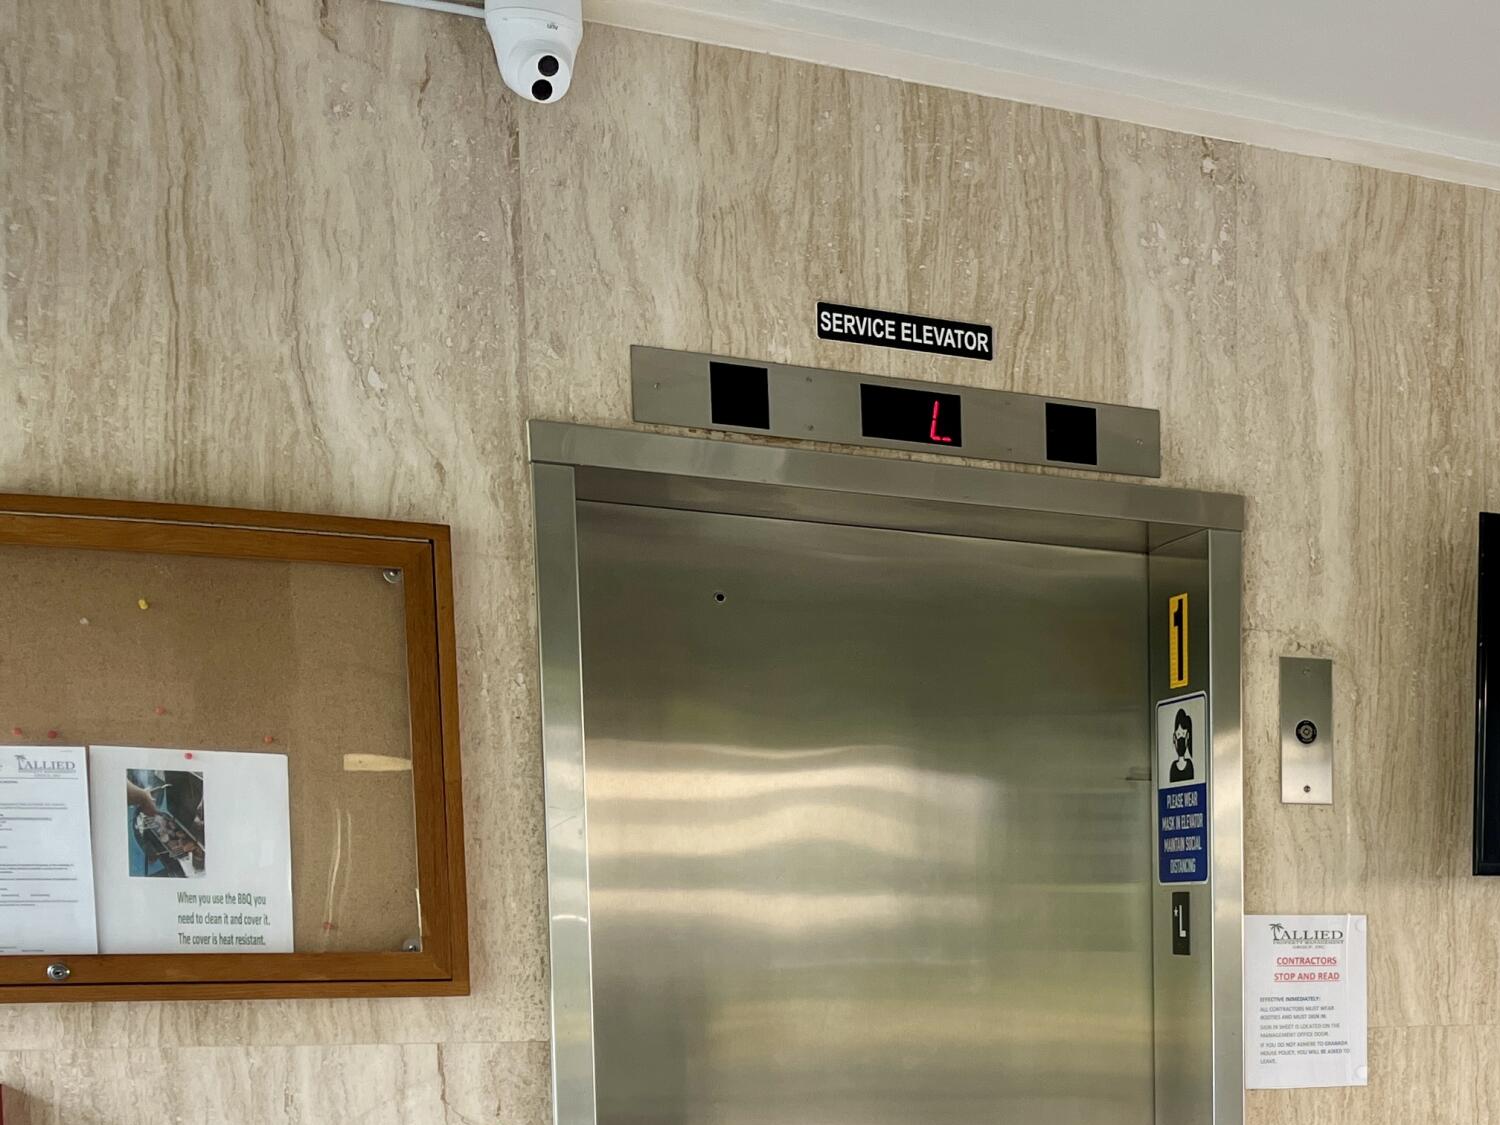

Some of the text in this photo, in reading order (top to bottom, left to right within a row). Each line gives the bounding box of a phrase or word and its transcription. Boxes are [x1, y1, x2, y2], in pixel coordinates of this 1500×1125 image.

[820, 311, 989, 352] SERVICE ELEVATOR
[930, 400, 952, 442] L
[1173, 598, 1184, 682] 1
[24, 760, 76, 770] ALLIED
[1166, 790, 1198, 809] PLEASE WEAR
[1162, 813, 1204, 831] MASK IN ELEVATOR
[1164, 835, 1202, 852] MAINTAIN SOCIAL
[1169, 858, 1196, 873] DISTANCING
[177, 891, 266, 907] When you use the BBQ you
[177, 912, 271, 926] need to clean it and cover it.
[177, 932, 266, 946] The cover is heat resistant.
[1281, 929, 1344, 940] ALLIED
[1276, 956, 1337, 966] CONTRACTORS
[1273, 972, 1340, 981] STOP AND READ
